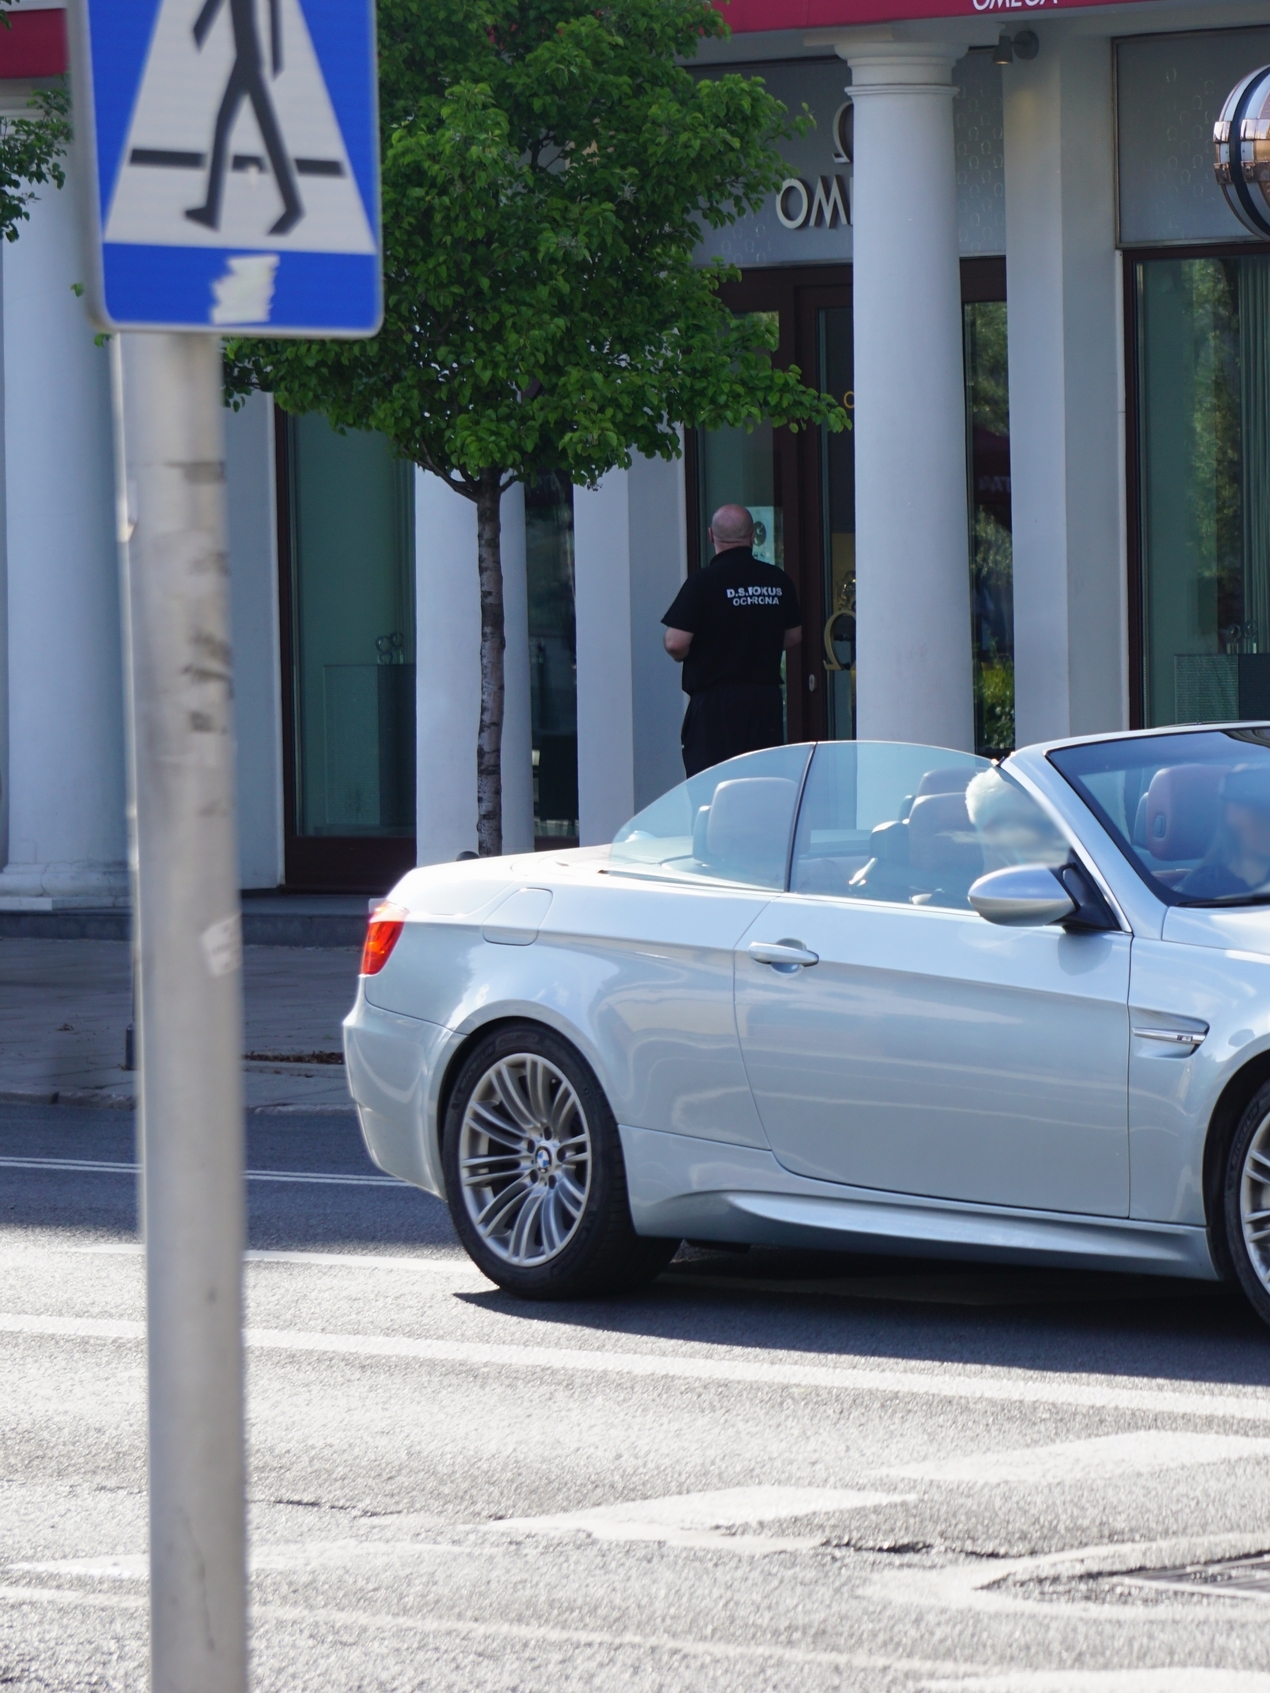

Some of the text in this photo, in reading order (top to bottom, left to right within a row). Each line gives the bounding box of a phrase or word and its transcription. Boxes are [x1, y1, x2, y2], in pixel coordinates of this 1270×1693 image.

[776, 175, 853, 229] OM
[726, 586, 783, 598] D.S.FOKUS
[733, 597, 780, 606] OCHRONA
